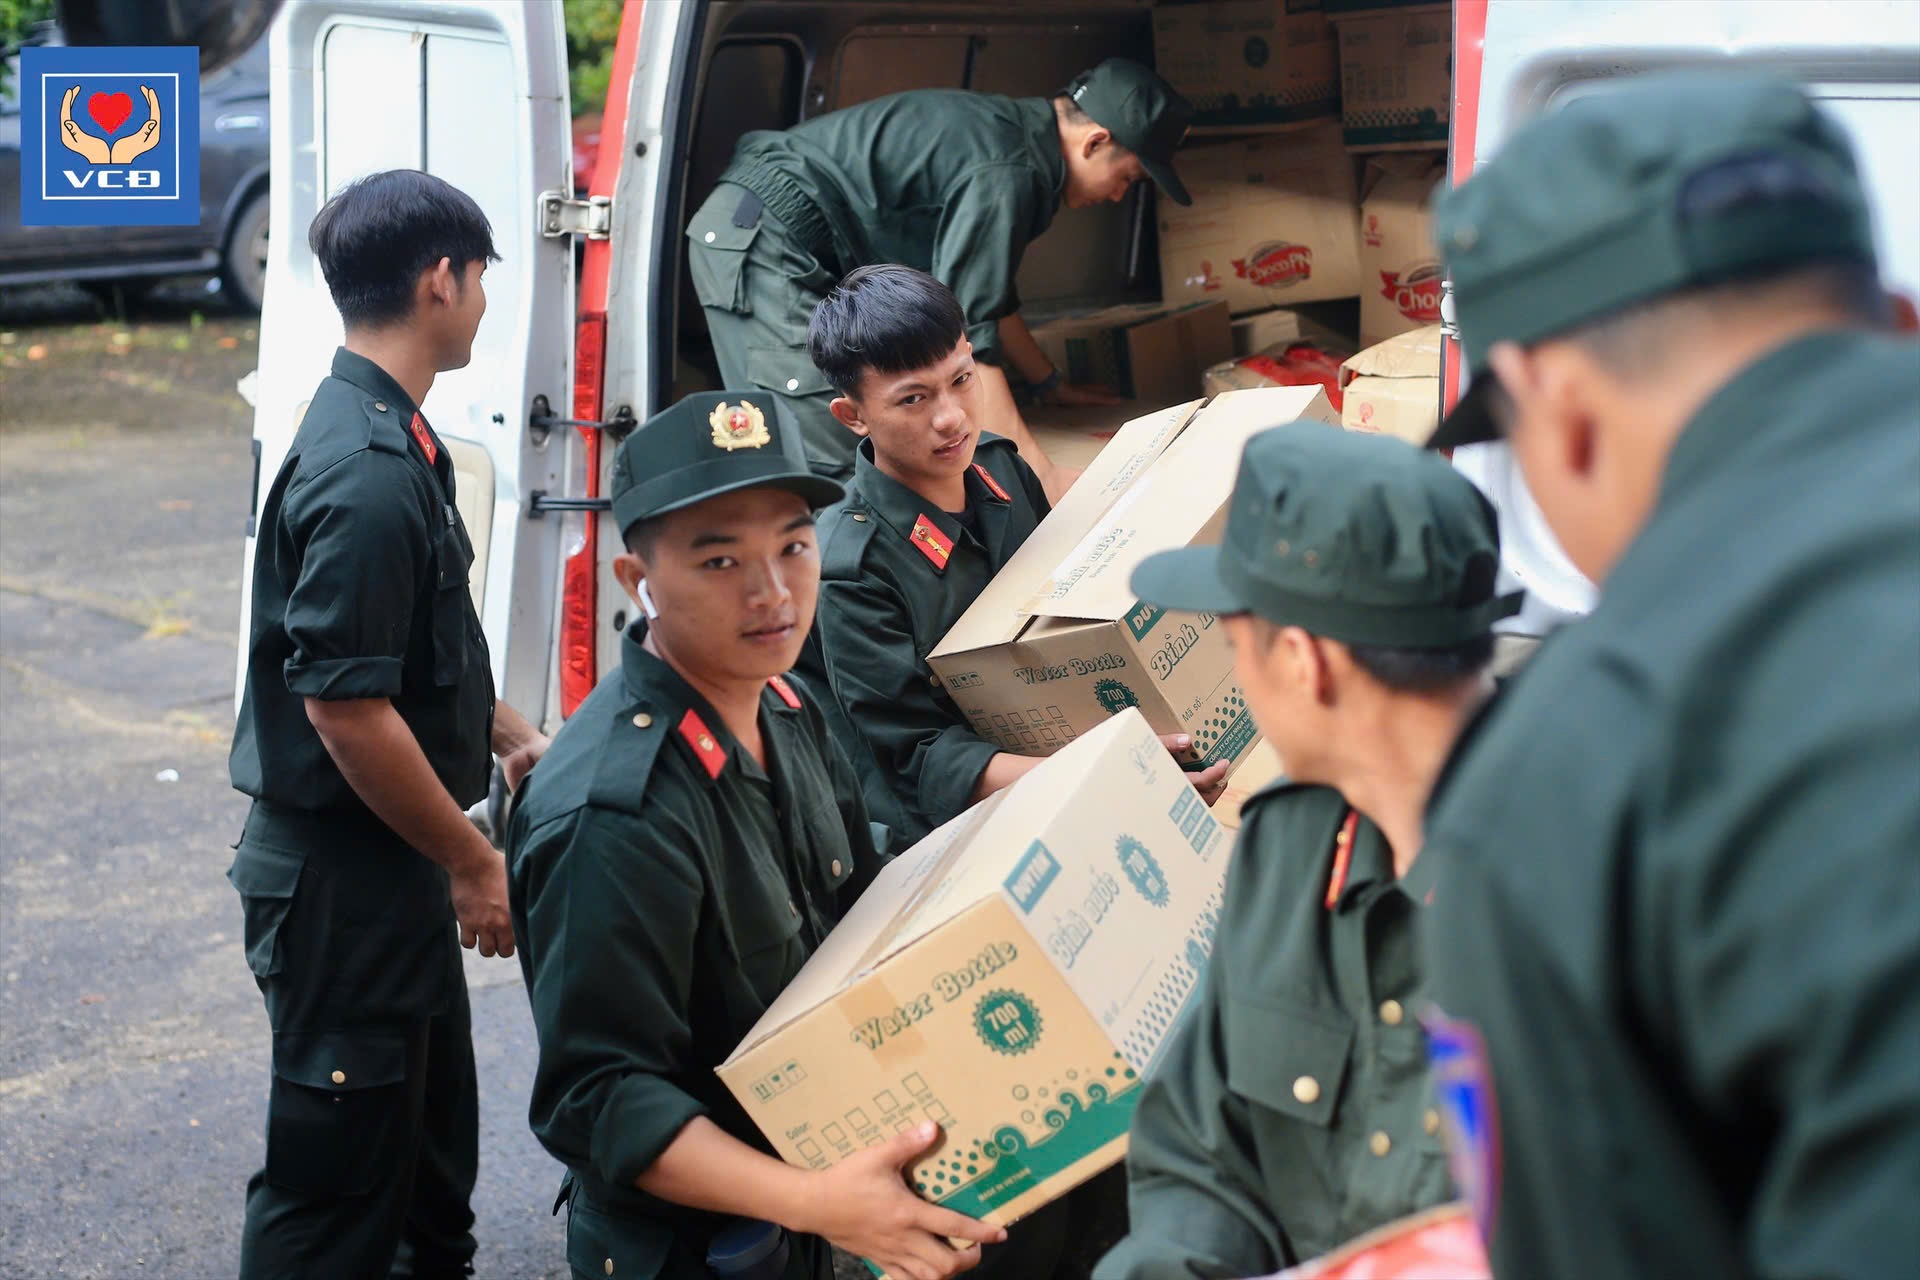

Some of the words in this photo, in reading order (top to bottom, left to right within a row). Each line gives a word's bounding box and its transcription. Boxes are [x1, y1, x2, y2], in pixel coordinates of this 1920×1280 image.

[1013, 666, 1069, 685] Water
[1068, 653, 1126, 676] Bottle
[1102, 688, 1126, 702] 700
[851, 993, 934, 1049] Water
[932, 942, 1018, 1002] Bottle
[984, 1001, 1020, 1031] 700
[1003, 1021, 1029, 1046] ml
